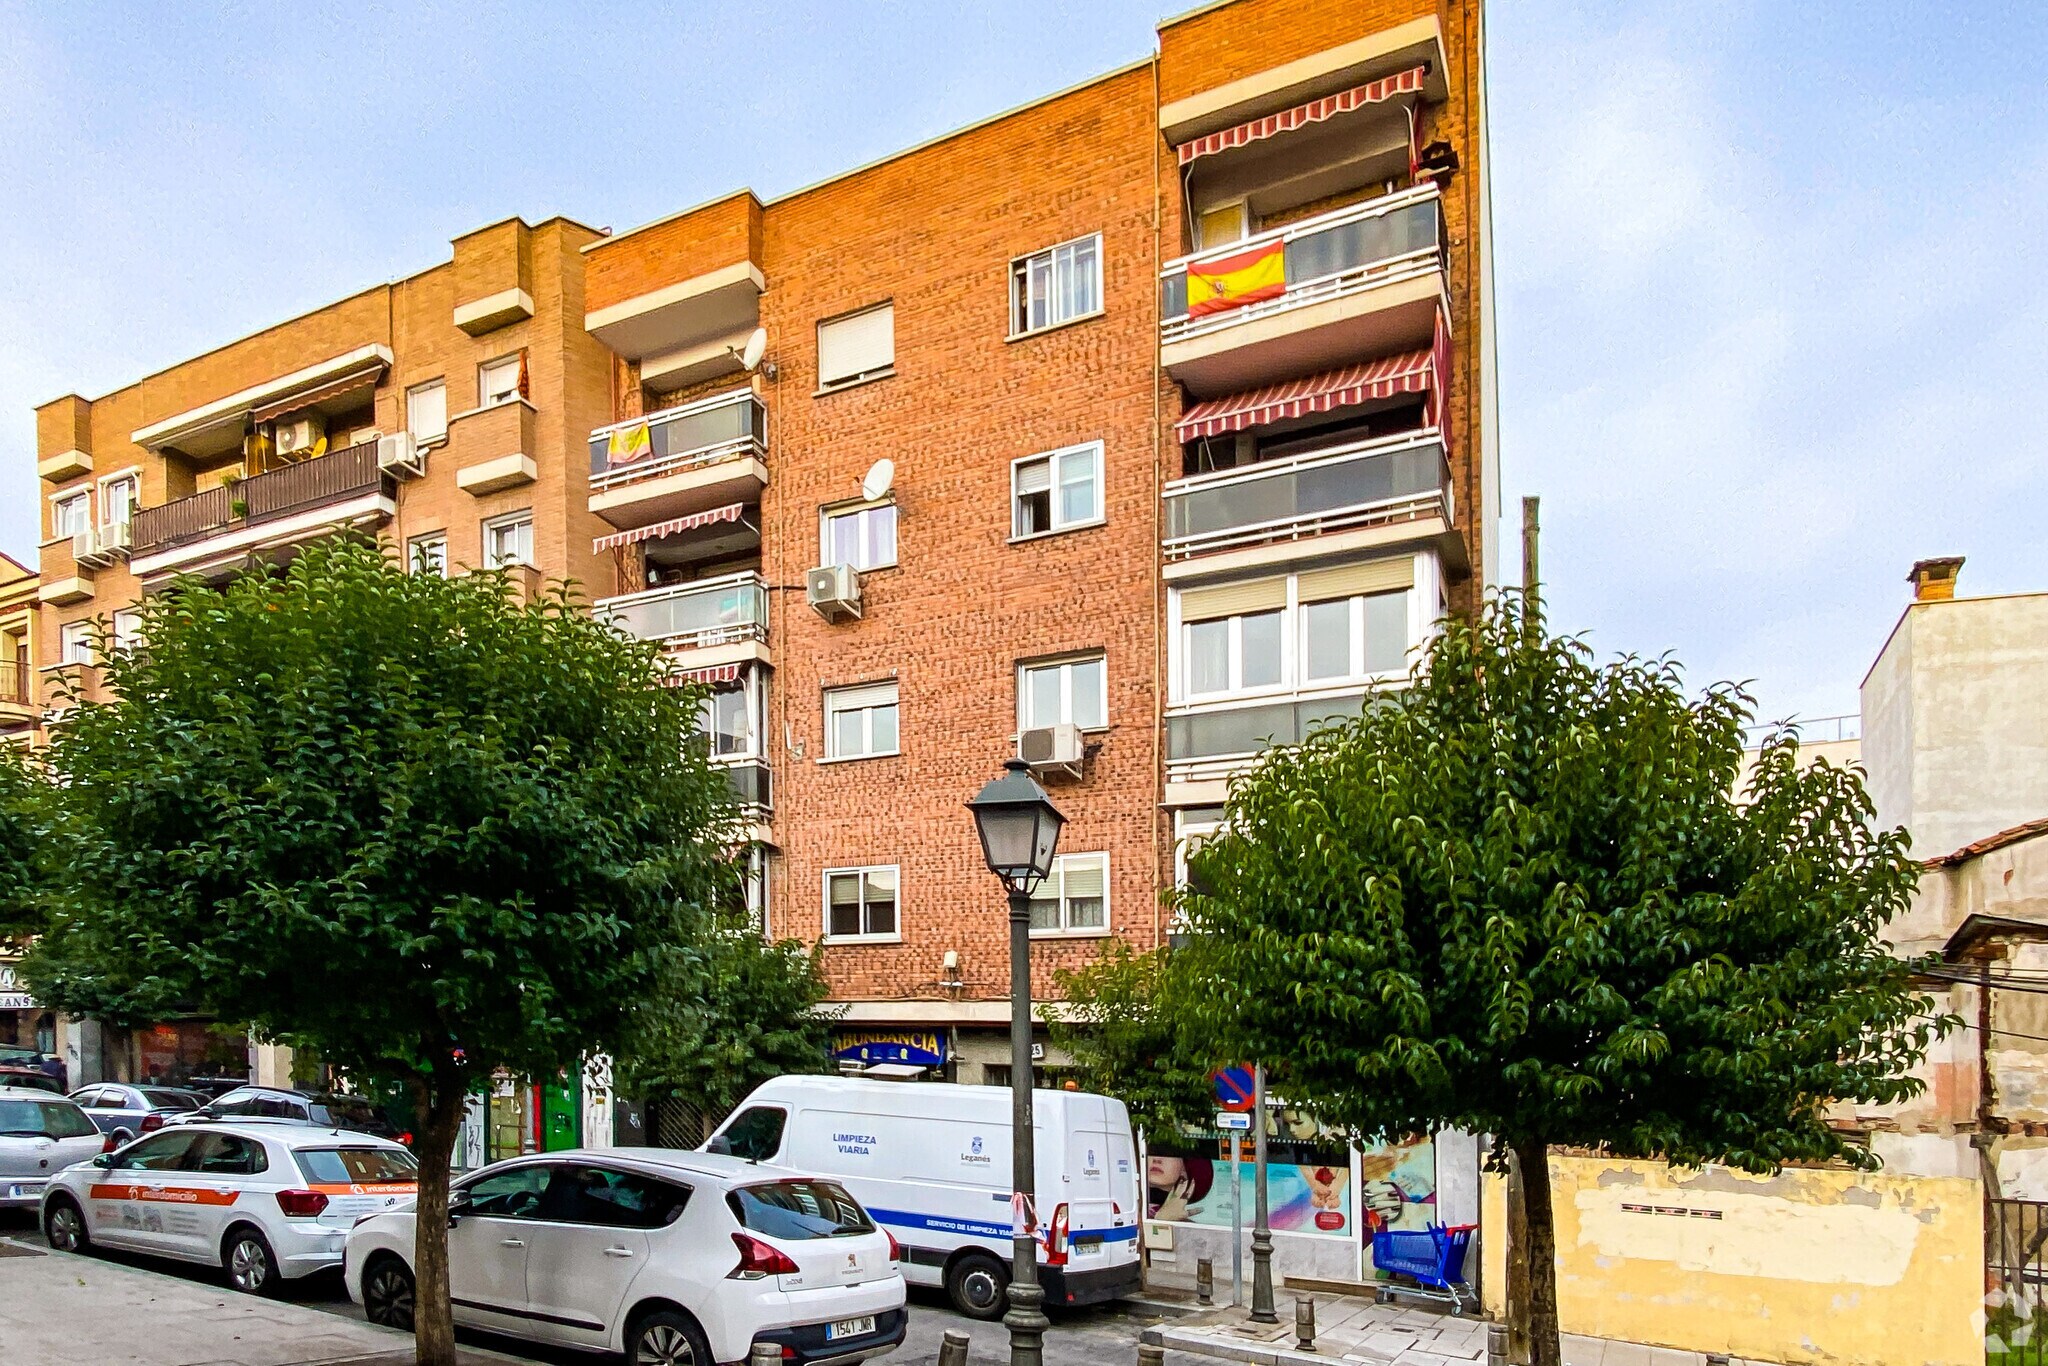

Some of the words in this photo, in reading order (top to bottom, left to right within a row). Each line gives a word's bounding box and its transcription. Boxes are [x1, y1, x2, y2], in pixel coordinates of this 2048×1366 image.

[831, 1032, 940, 1056] ABUNDANCIA
[833, 1133, 877, 1145] LIMPIEZA
[838, 1145, 869, 1155] VIARIA
[926, 1219, 956, 1230] SERVICIO
[956, 1223, 966, 1231] DE
[966, 1224, 998, 1235] LIMPIEZA
[835, 1321, 856, 1336] 1541
[858, 1317, 872, 1332] JMR
